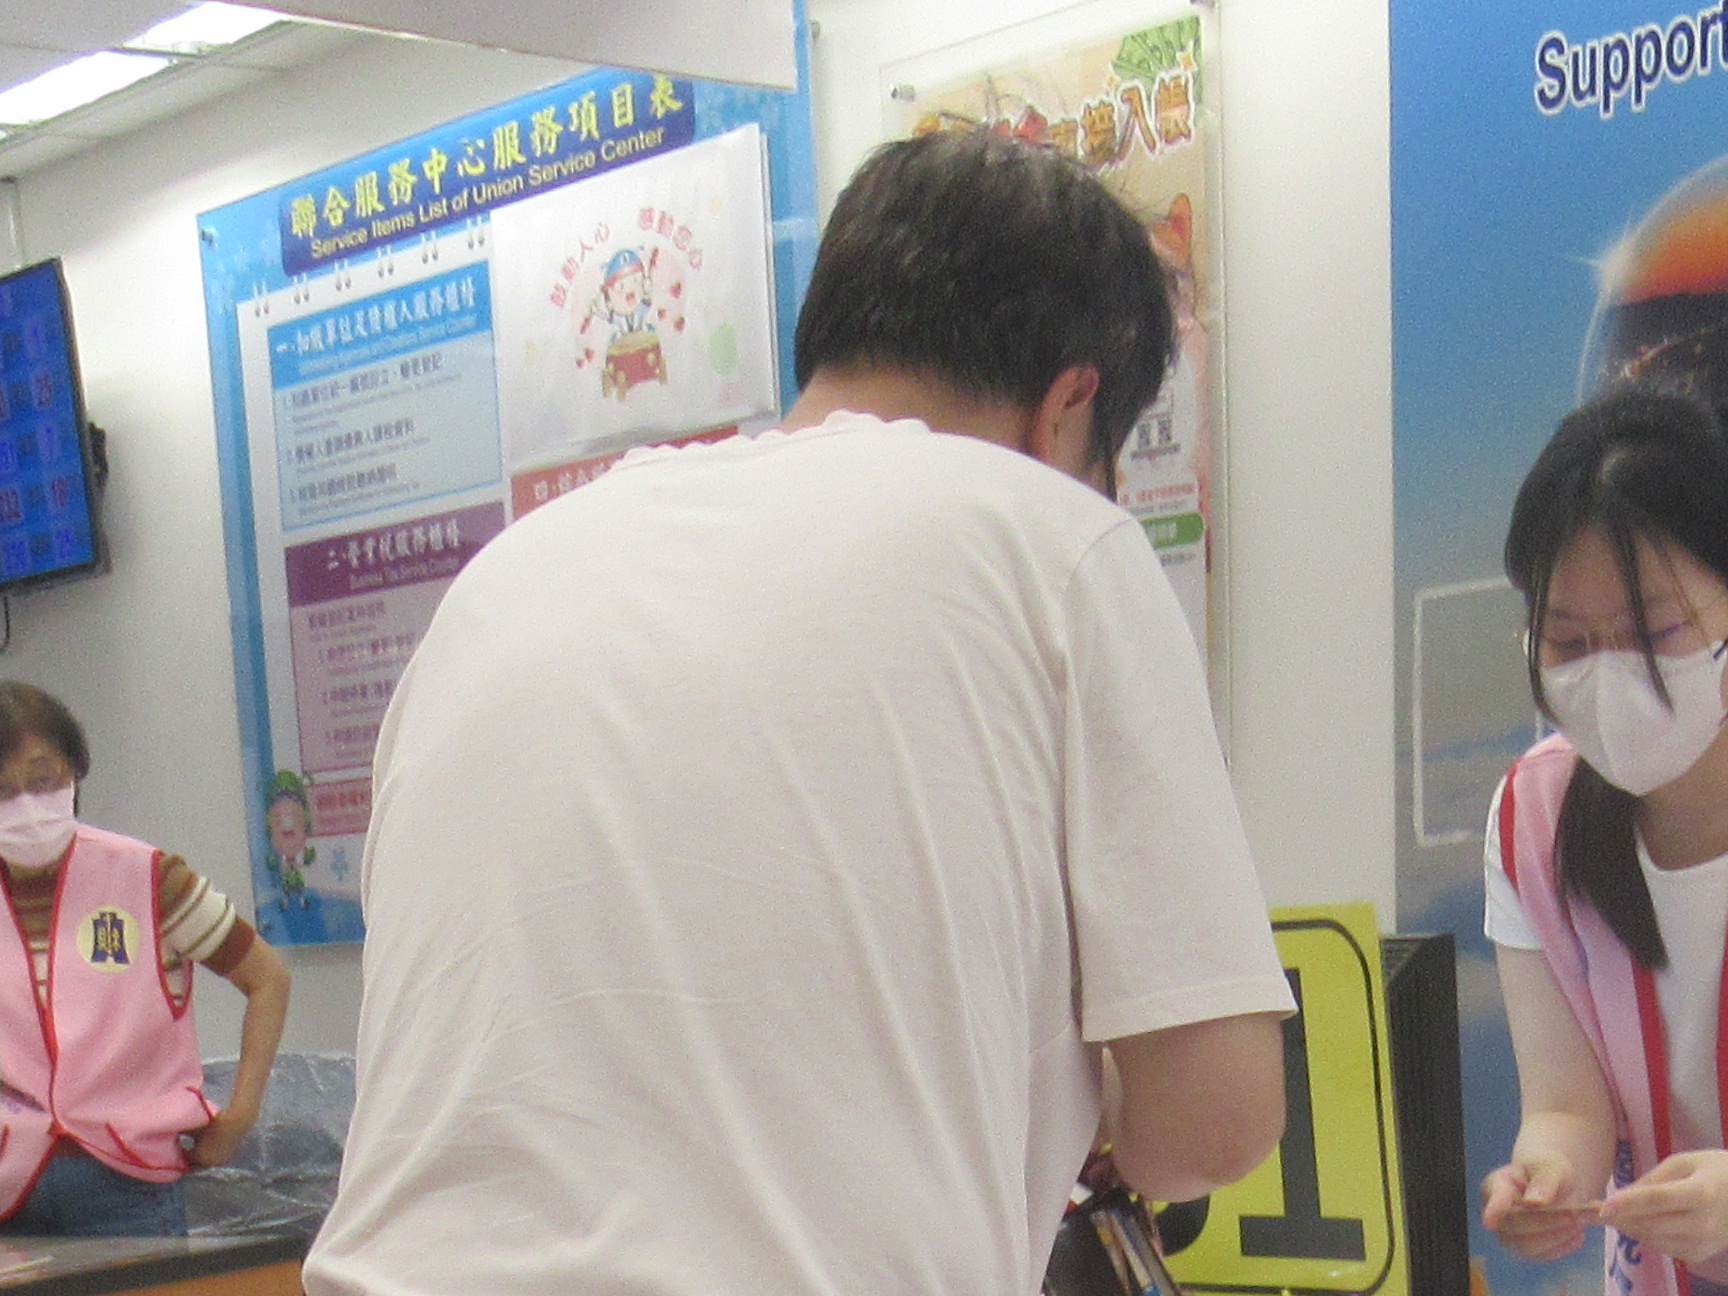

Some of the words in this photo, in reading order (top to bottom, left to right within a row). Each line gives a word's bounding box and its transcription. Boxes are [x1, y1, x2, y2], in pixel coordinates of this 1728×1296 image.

[291, 73, 684, 238] 聯合服務中心服務項目表
[311, 221, 368, 260] Service
[373, 208, 415, 238] Items
[419, 199, 448, 222] List
[452, 192, 468, 212] of
[473, 174, 524, 207] Union
[529, 150, 596, 185] Service
[600, 125, 665, 163] Center
